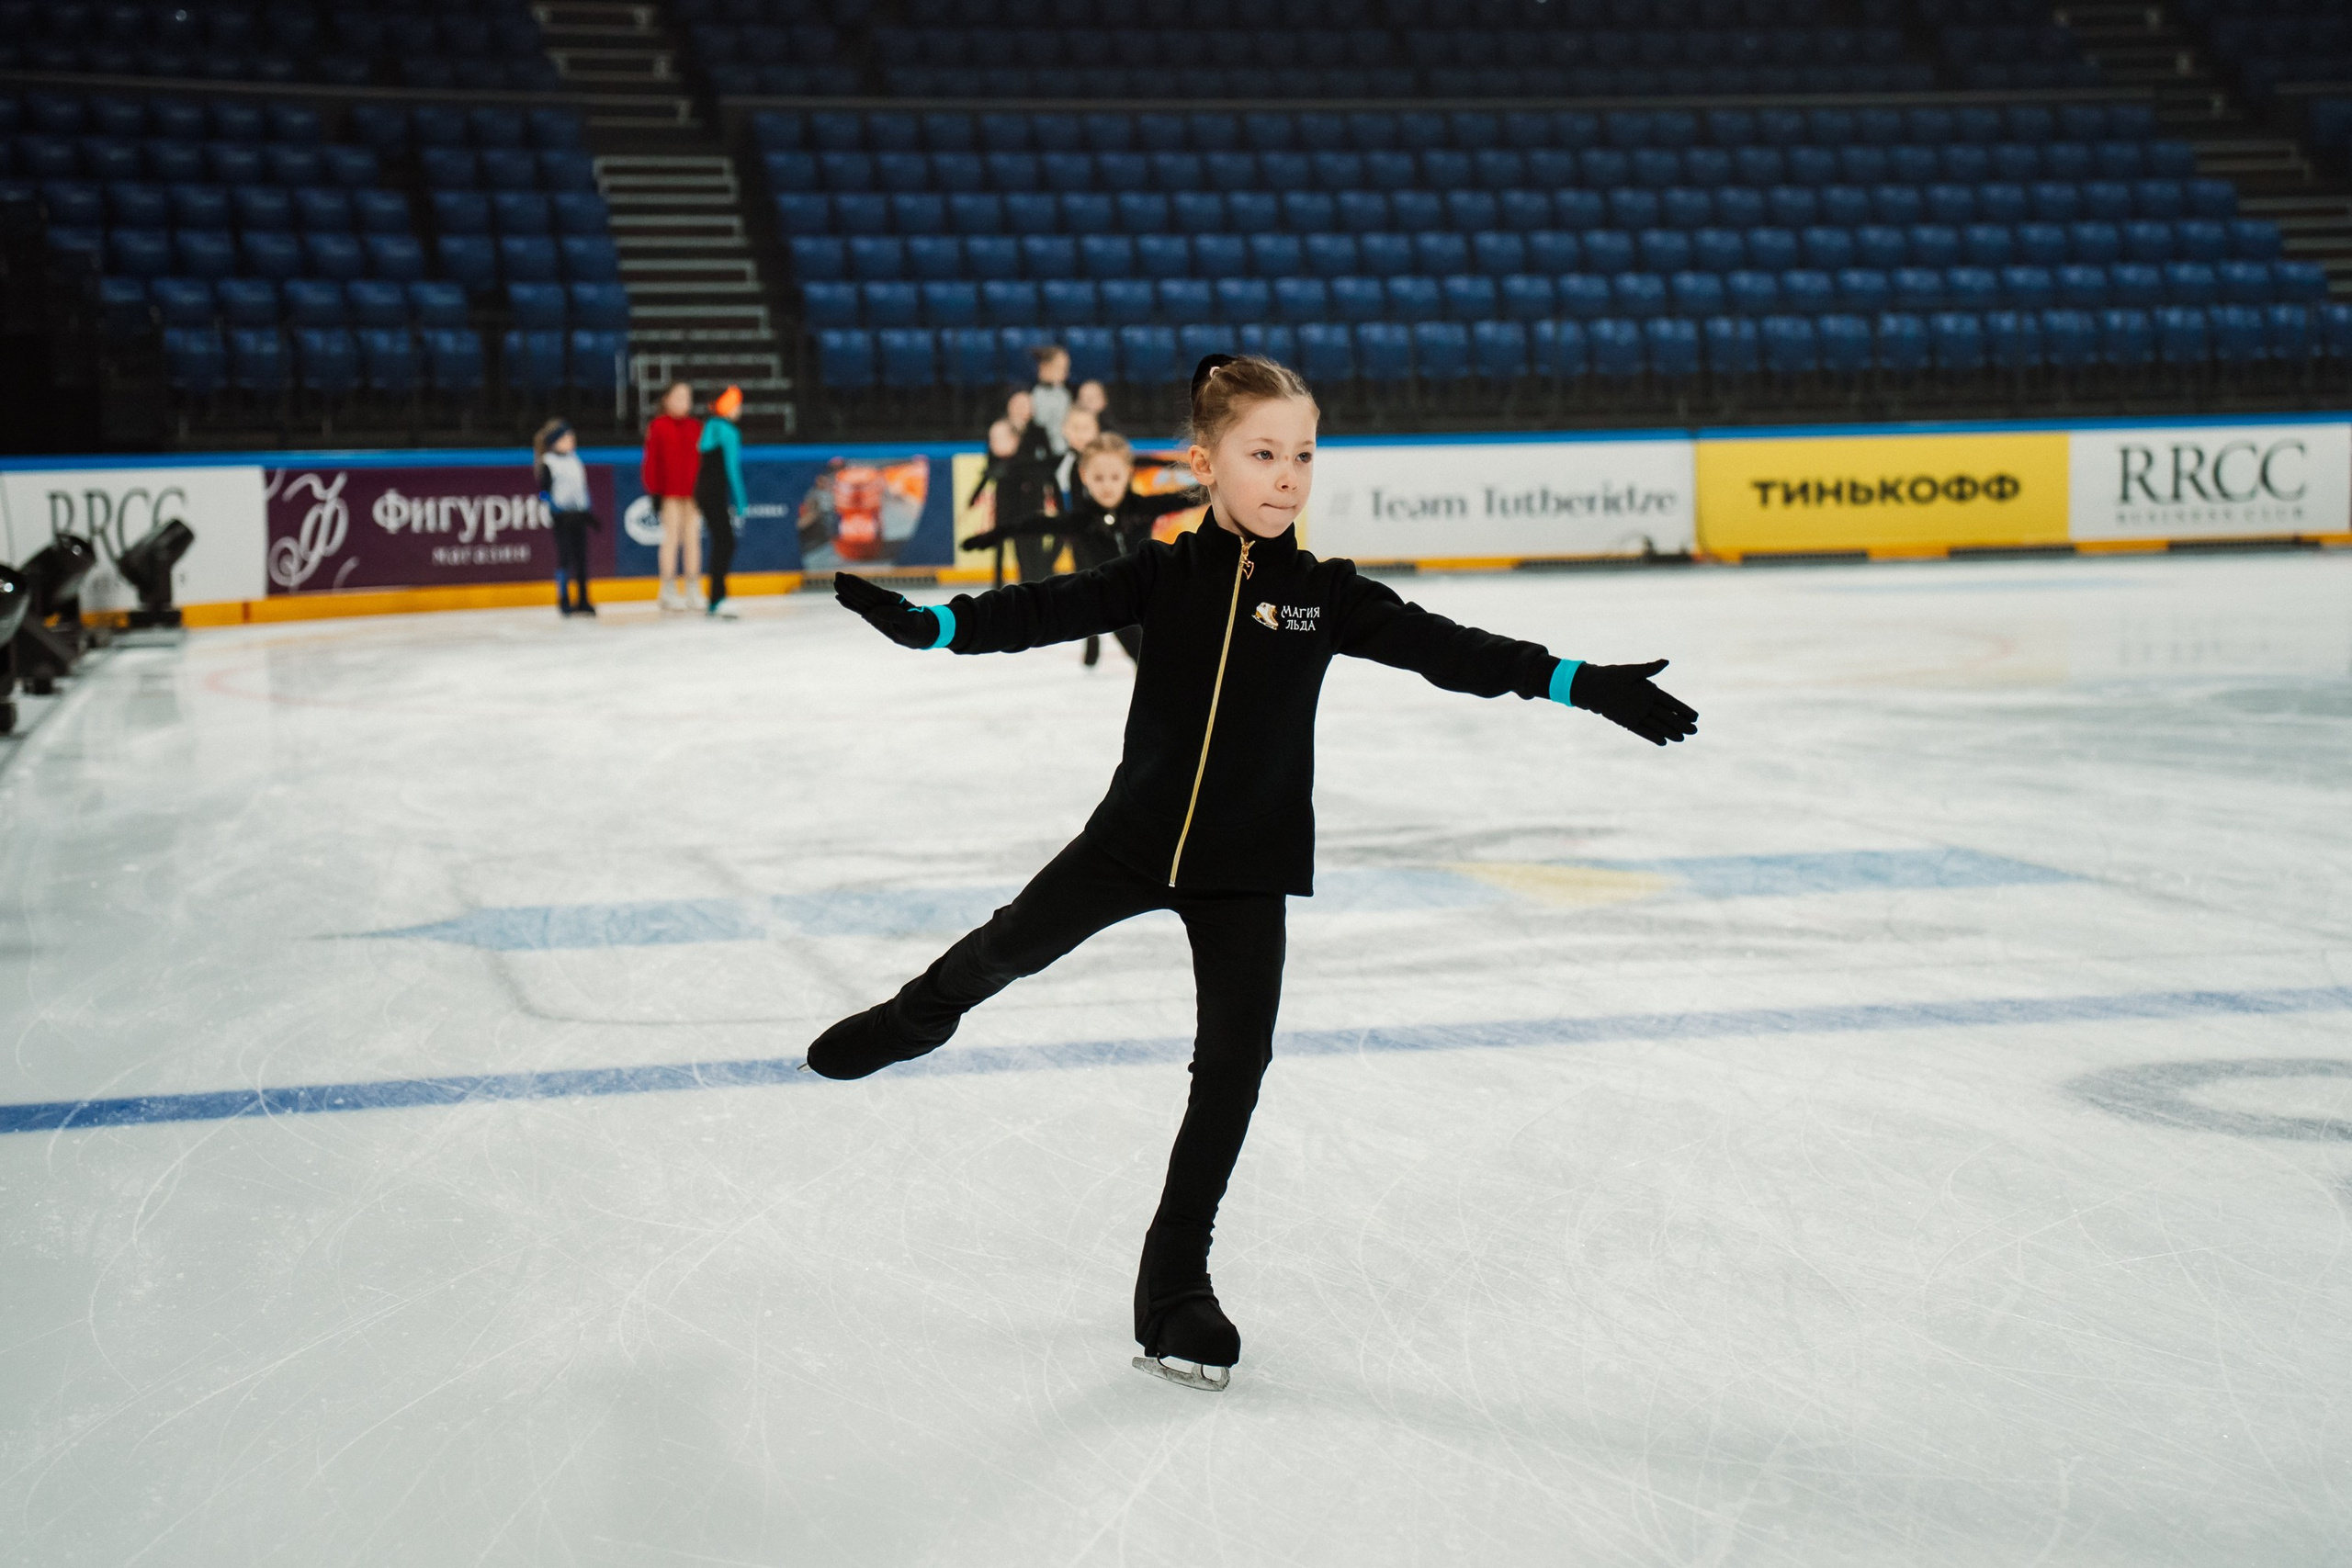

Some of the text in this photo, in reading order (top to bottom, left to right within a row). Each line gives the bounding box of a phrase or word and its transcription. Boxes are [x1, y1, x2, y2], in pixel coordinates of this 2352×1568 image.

[2119, 440, 2307, 503] RRCC
[1751, 473, 2021, 507] ТИНЬКОФФ
[1281, 605, 1320, 618] МАГИЯ
[1285, 619, 1316, 632] ЛЬДА
